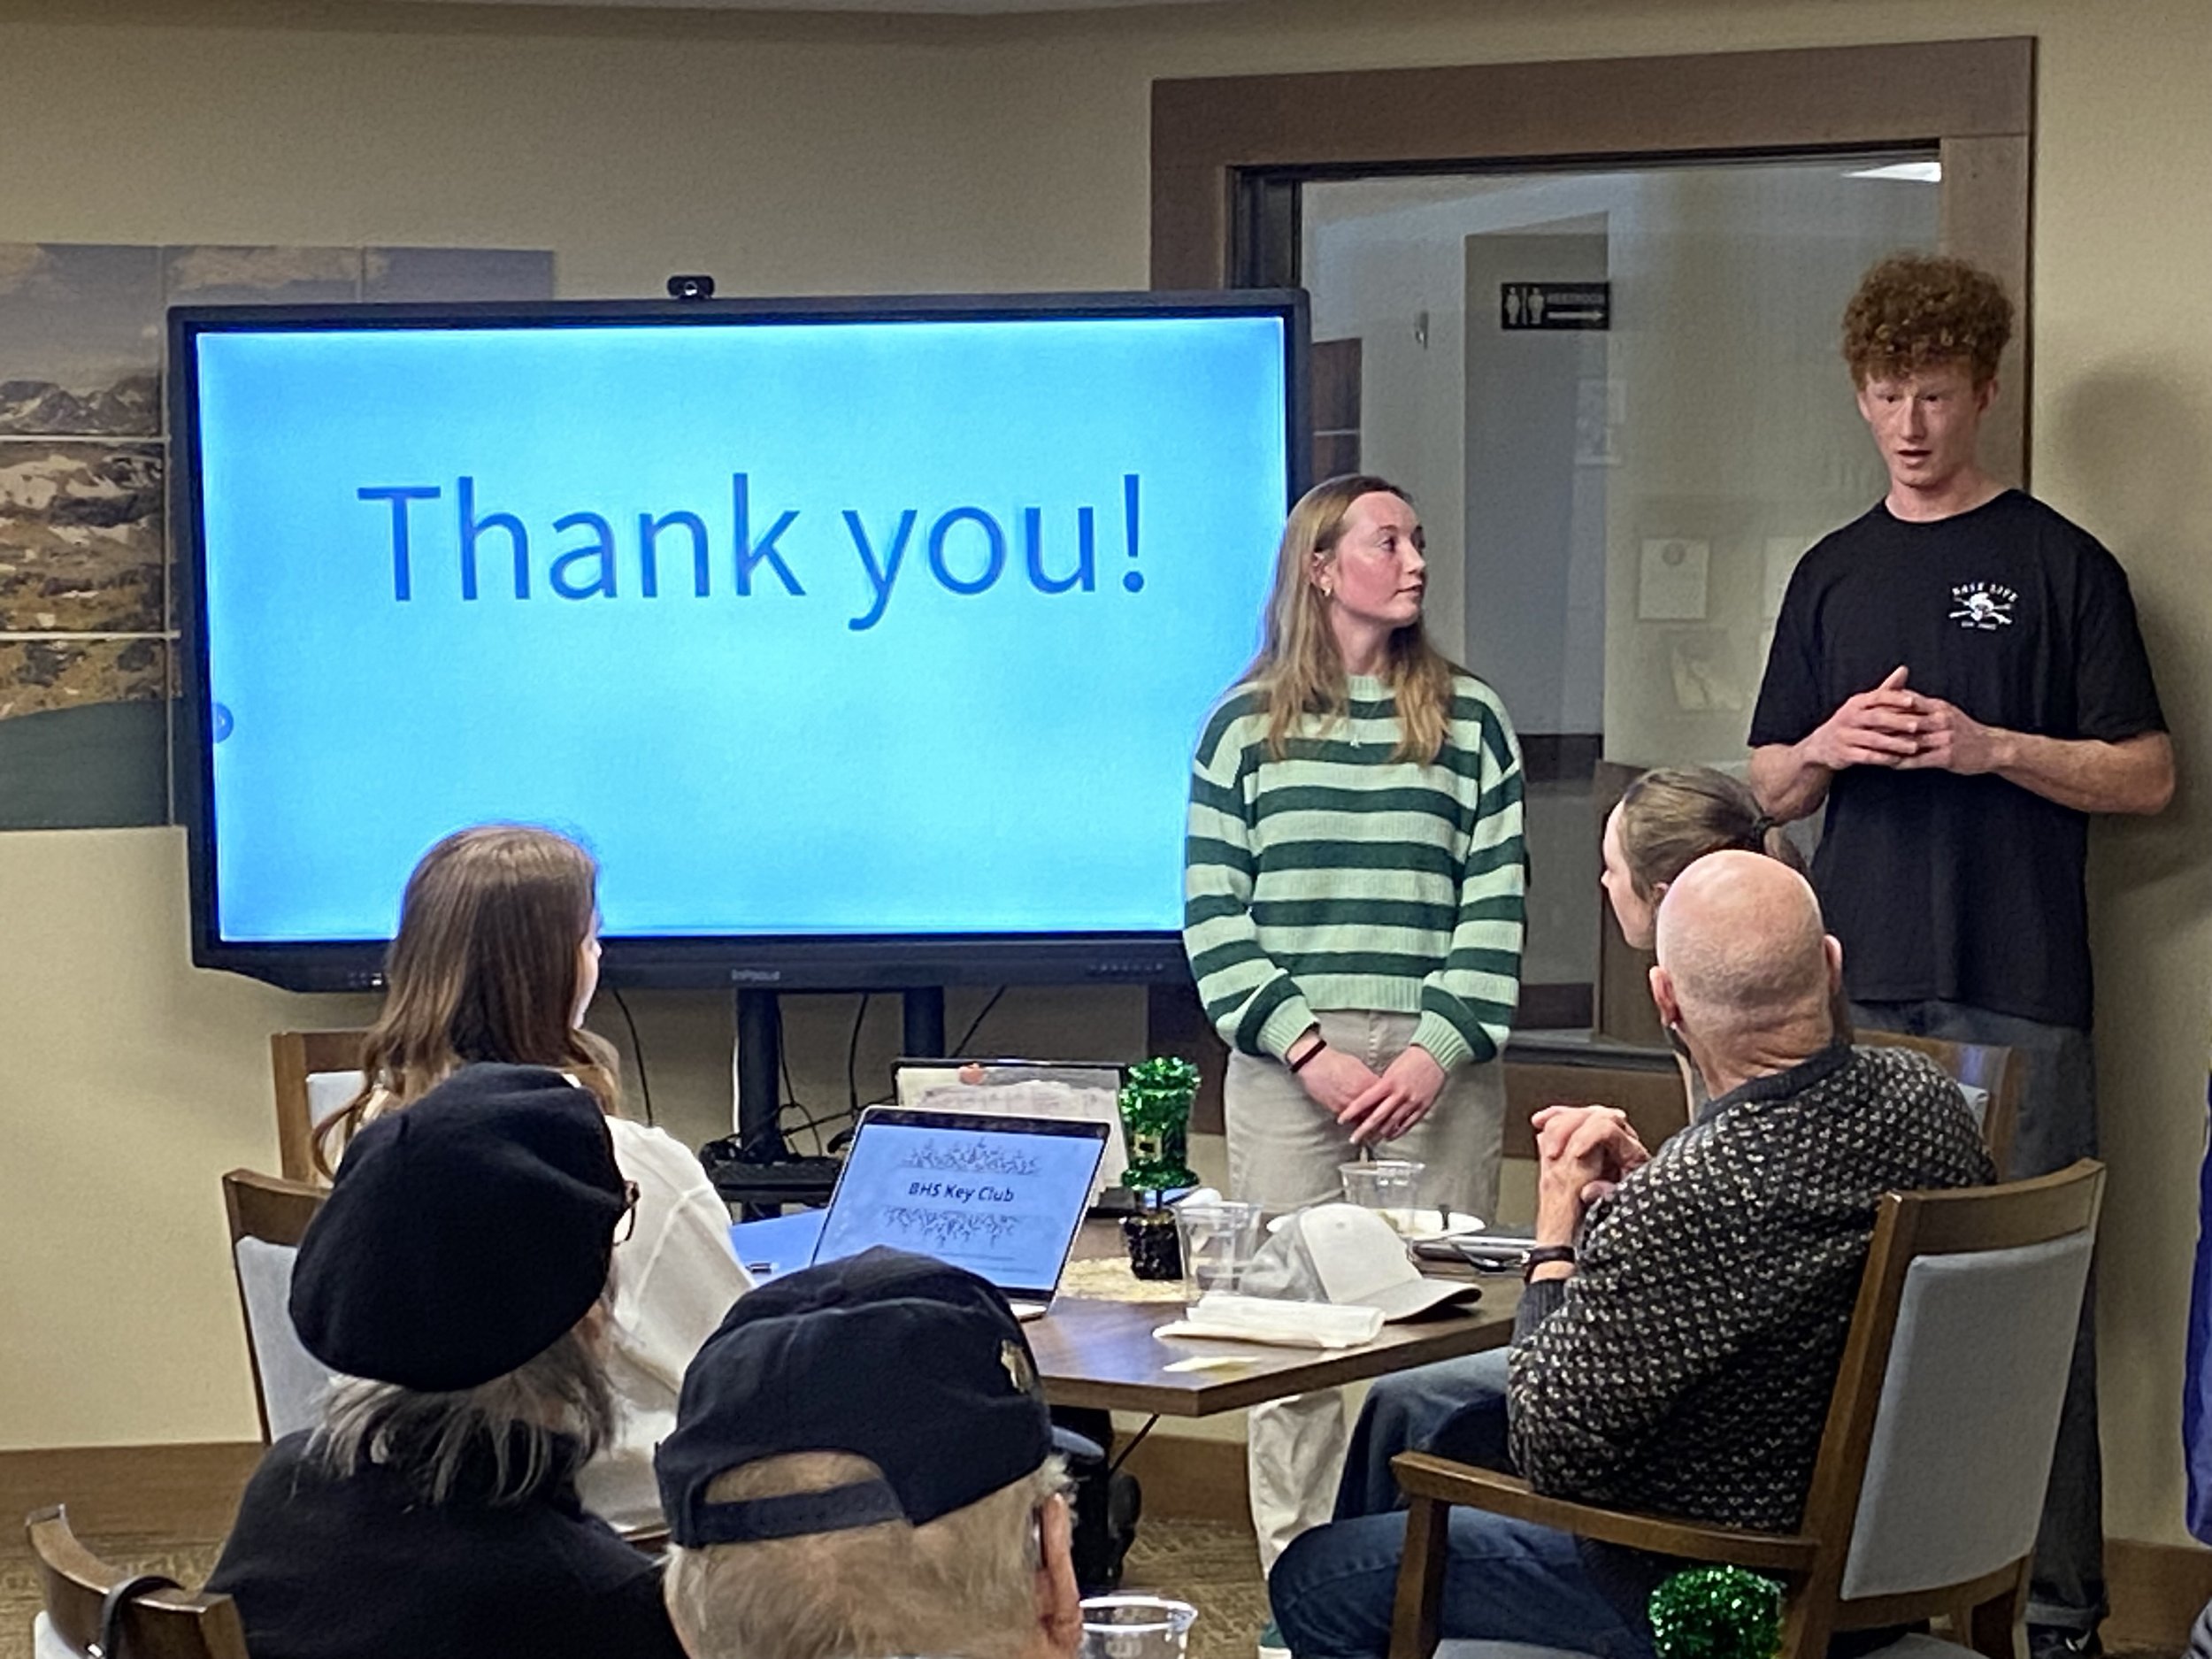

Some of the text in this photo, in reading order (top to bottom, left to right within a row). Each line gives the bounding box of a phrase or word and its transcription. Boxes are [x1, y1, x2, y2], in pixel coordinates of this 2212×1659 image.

[357, 472, 1145, 631] Thank you!
[908, 1182, 1015, 1203] BHS Key Club
